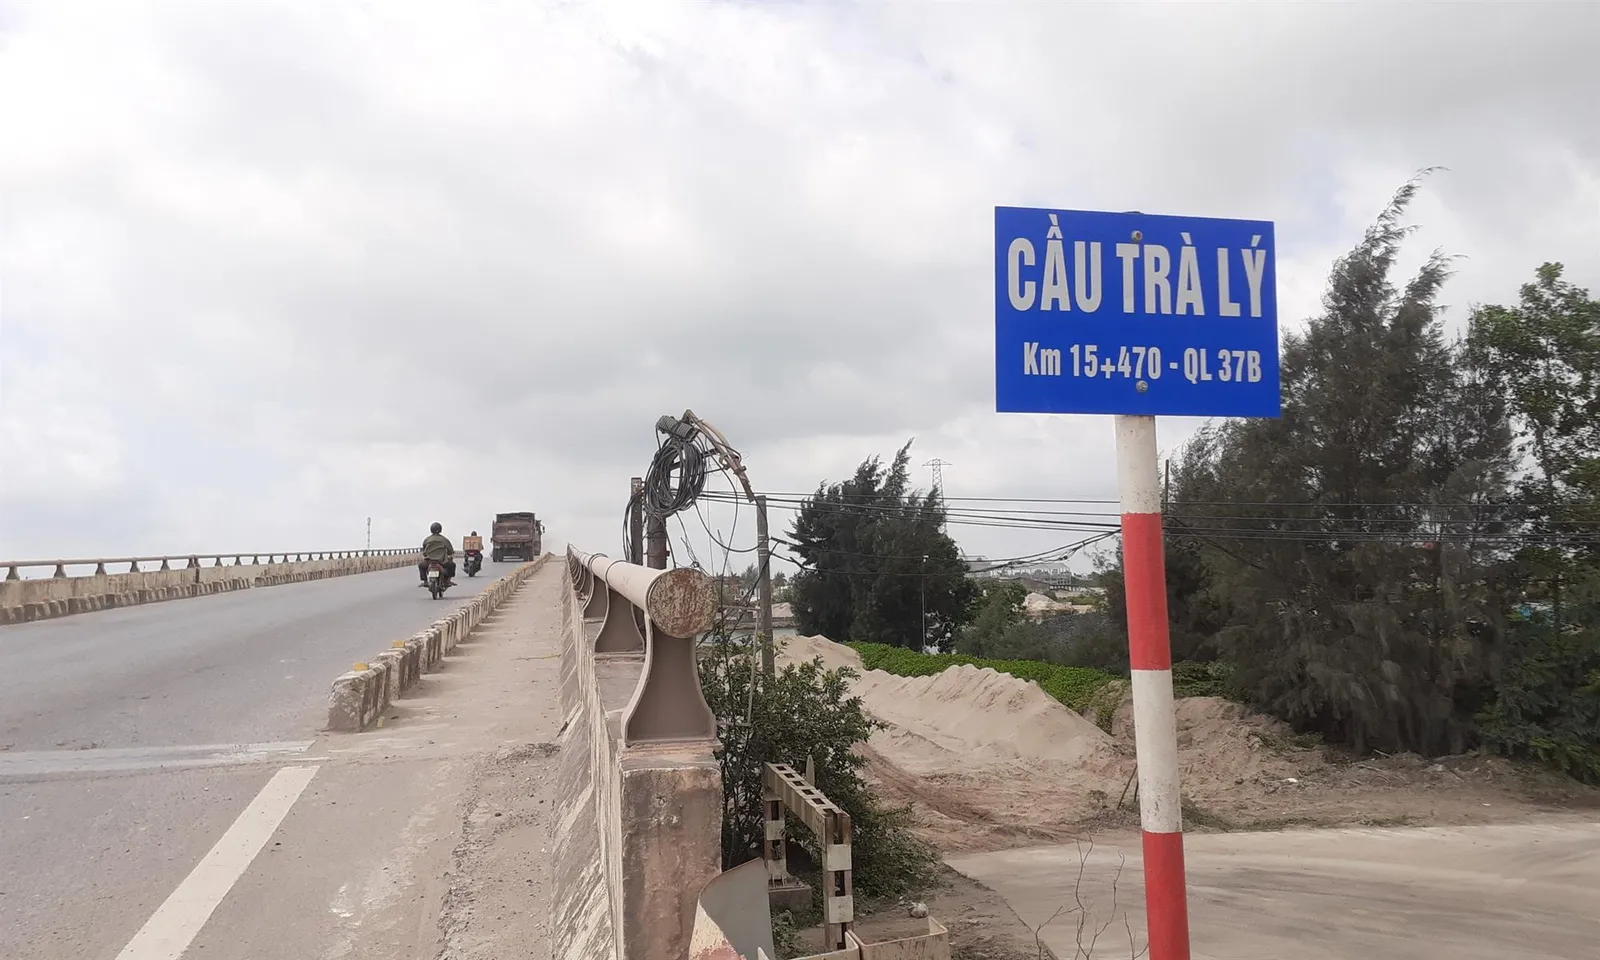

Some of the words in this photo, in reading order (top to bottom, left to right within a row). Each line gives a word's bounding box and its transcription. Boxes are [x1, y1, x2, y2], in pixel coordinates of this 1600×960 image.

[1007, 213, 1103, 313] CẦU
[1115, 231, 1206, 316] TRÀ
[1216, 234, 1267, 318] LÝ
[1023, 341, 1062, 376] Km
[1070, 344, 1162, 380] 15+470
[1183, 347, 1213, 385] QL
[1218, 348, 1262, 383] 37B
